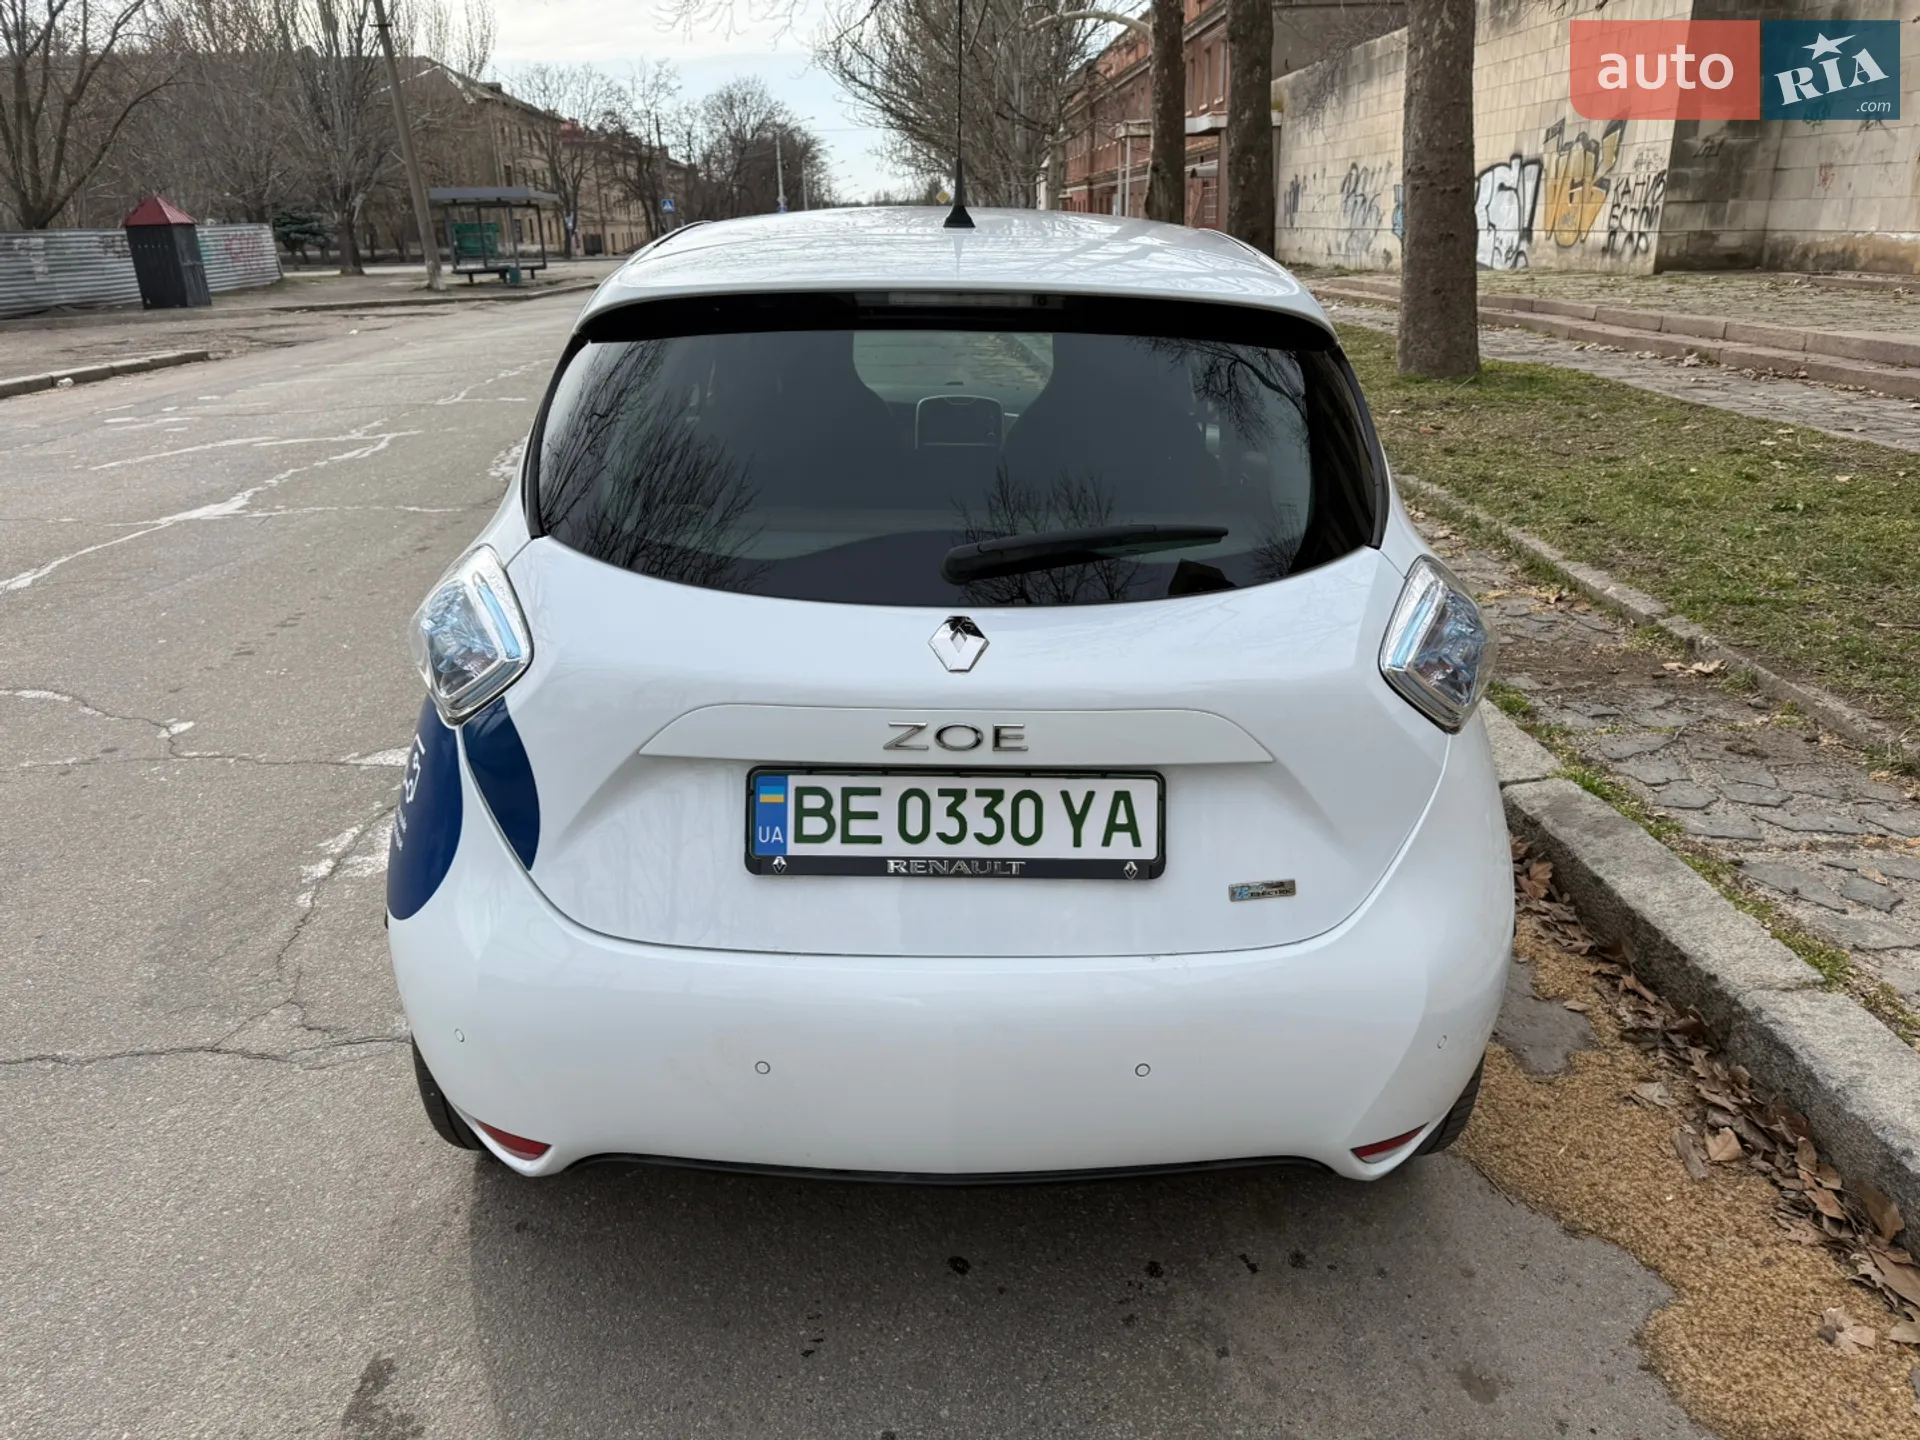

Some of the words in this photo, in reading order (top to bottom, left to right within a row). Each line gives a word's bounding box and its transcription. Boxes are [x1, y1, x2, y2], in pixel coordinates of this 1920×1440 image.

[883, 722, 1029, 751] ZOE
[793, 786, 882, 844] BE
[898, 787, 1044, 847] 0330
[1060, 790, 1143, 848] YA
[758, 826, 784, 844] UA
[887, 859, 1025, 876] RENAULT
